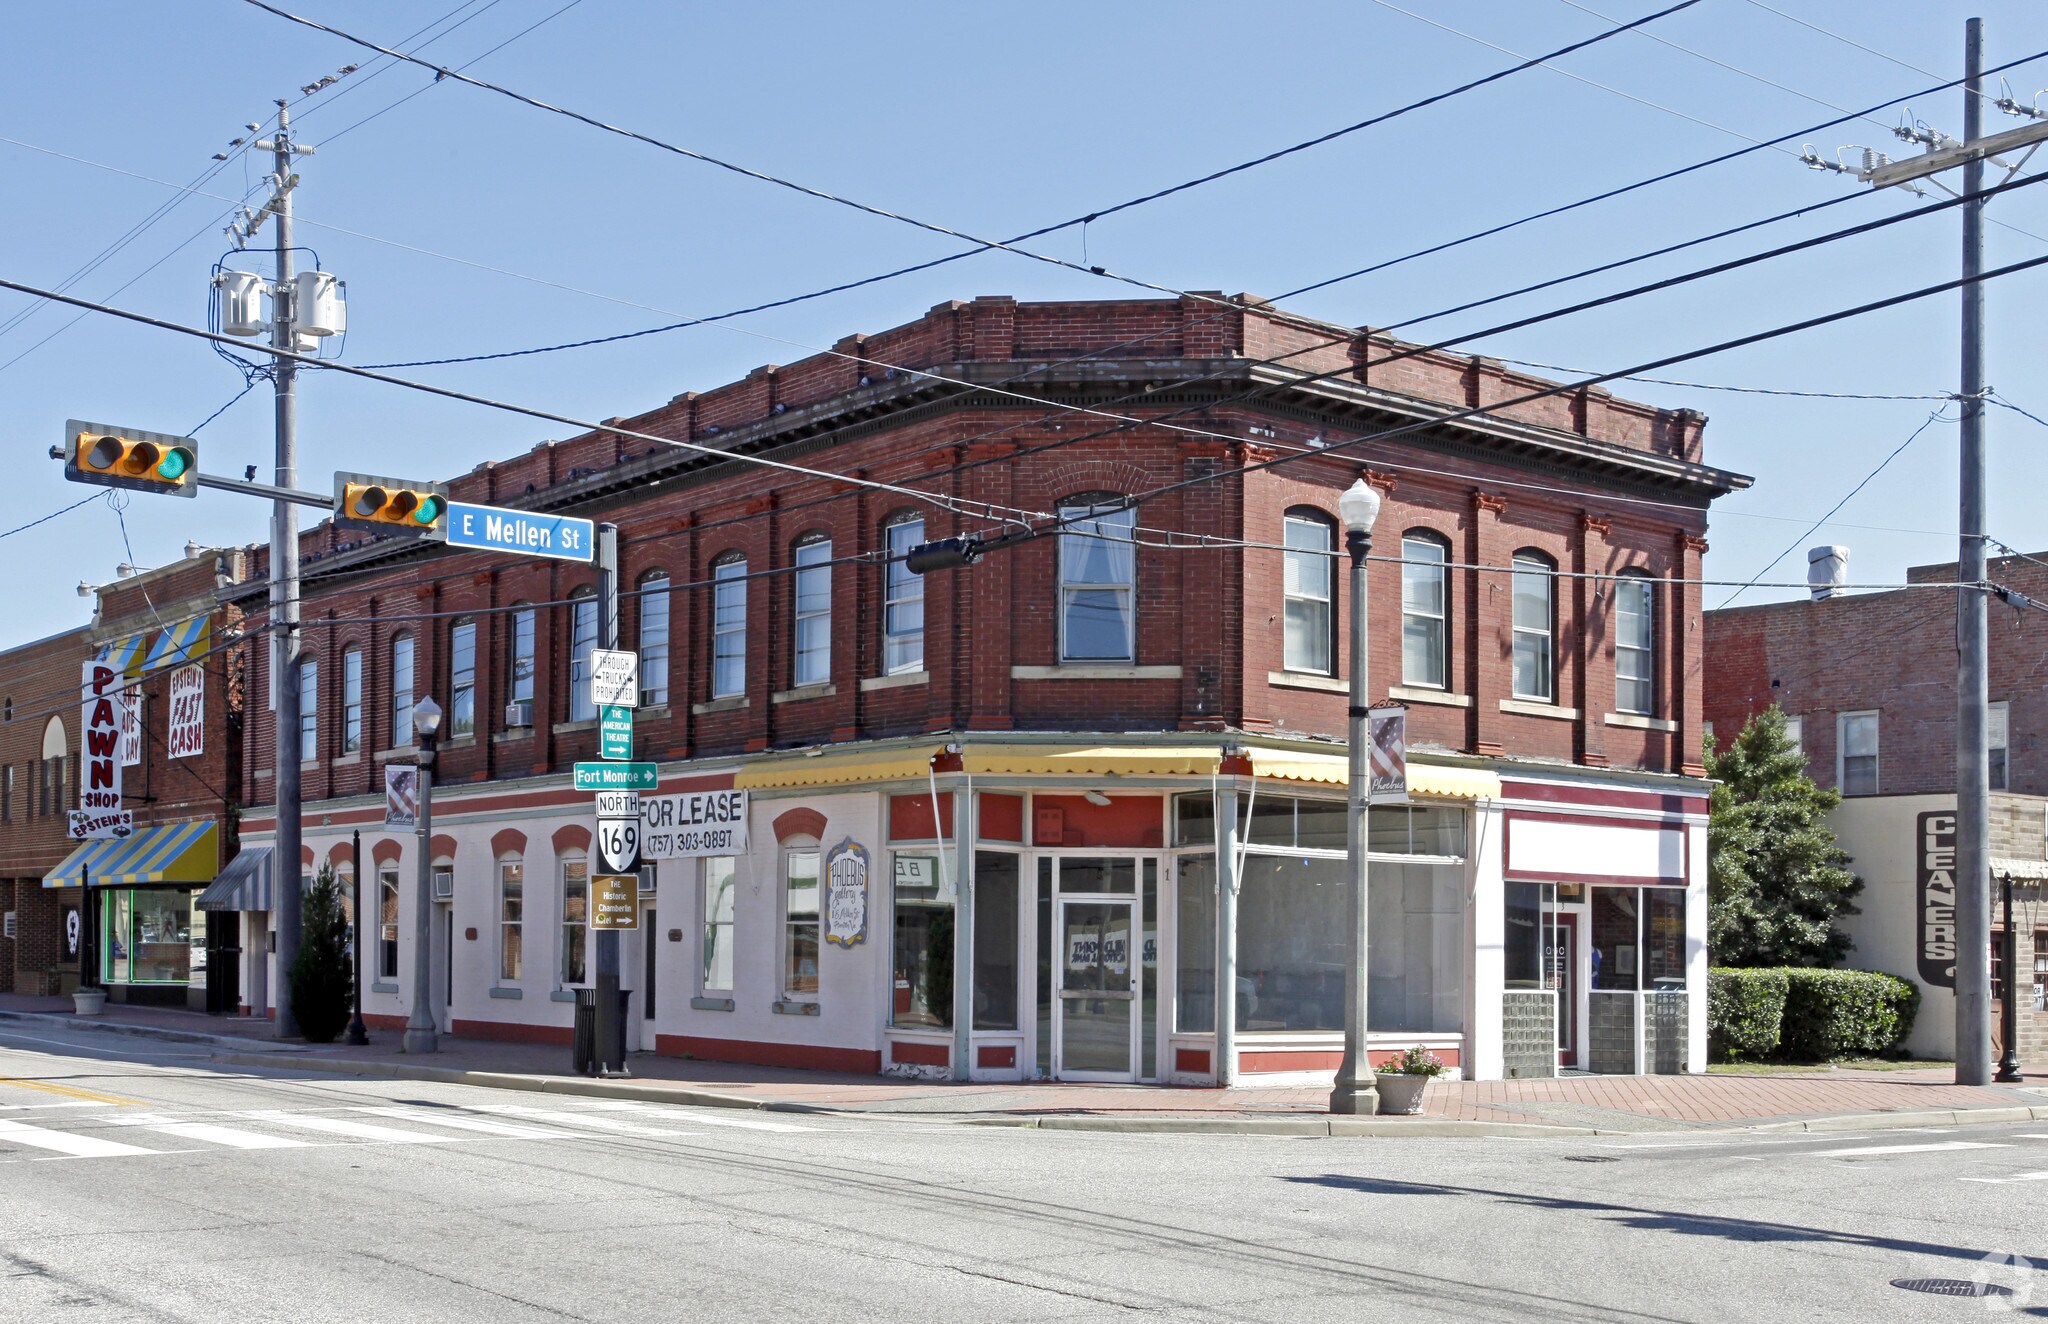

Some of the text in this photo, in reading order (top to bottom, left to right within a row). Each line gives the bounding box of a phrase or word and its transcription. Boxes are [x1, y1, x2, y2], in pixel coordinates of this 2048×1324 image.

[463, 514, 580, 549] E Mellen St
[599, 656, 630, 671] THROUGH
[172, 667, 202, 695] EPSTEIN'S
[602, 671, 627, 685] TRUCKS
[596, 685, 633, 700] PROHIBITED
[171, 692, 203, 726] FAST
[611, 709, 622, 719] THE
[87, 666, 119, 790] PAWN
[603, 721, 631, 731] AMERICAN
[170, 721, 202, 755] CASH
[605, 732, 630, 743] THEATRE
[126, 736, 139, 762] DAY
[577, 770, 639, 783] Fort Monroe
[1371, 776, 1404, 790] Phoebus
[85, 792, 119, 808] SHOP
[599, 796, 638, 811] NORTH
[640, 792, 742, 828] FOR LEASE
[72, 813, 131, 838] EPSTEIN'S
[602, 826, 636, 855] 169
[647, 830, 732, 856] (757) 303-0897
[830, 858, 865, 887] PHOEBUS
[1165, 868, 1170, 881] 1
[610, 880, 621, 888] THE
[1925, 816, 1956, 960] CLEANERS
[603, 892, 627, 900] Historic
[598, 904, 632, 913] Chamberlin
